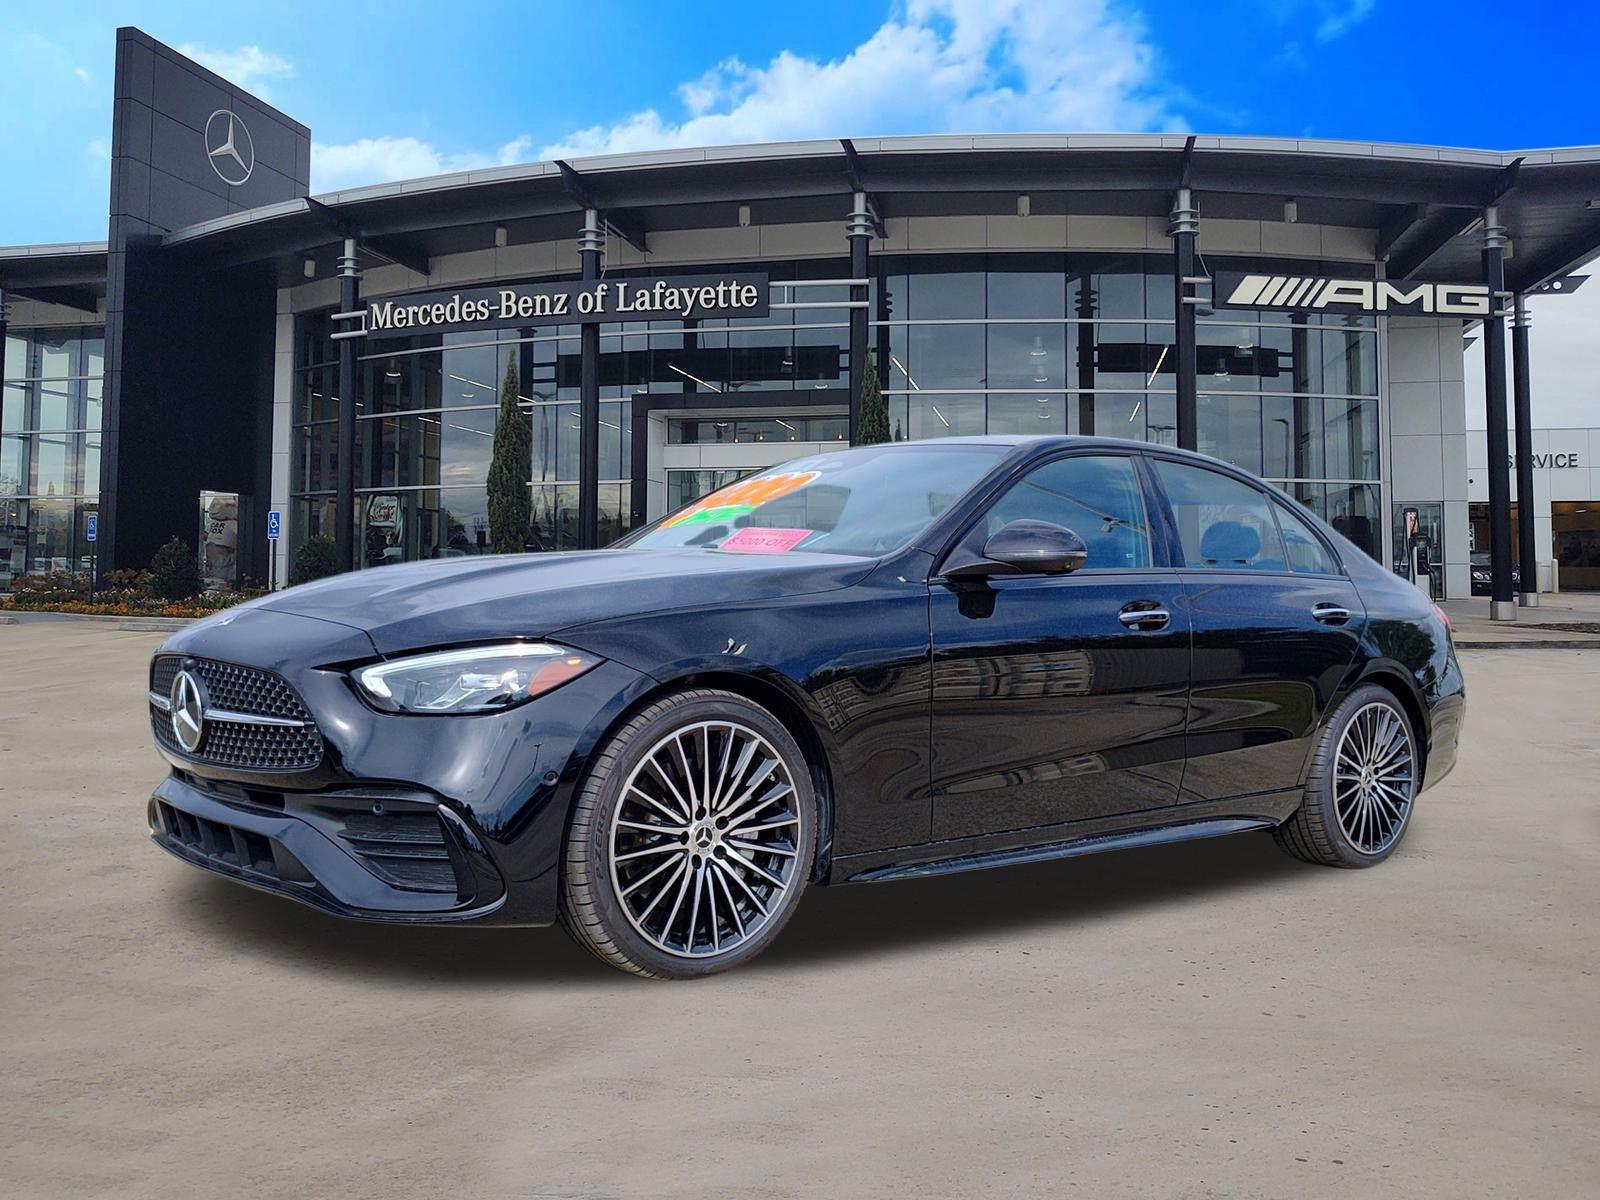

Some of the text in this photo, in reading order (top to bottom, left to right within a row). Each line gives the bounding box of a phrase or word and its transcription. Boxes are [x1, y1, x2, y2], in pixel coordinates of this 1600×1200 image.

[370, 280, 759, 330] Mercedes-Benz of Lafayette
[1313, 279, 1490, 314] AMG
[1507, 453, 1579, 468] SRVICE
[595, 806, 606, 881] P ZERO
